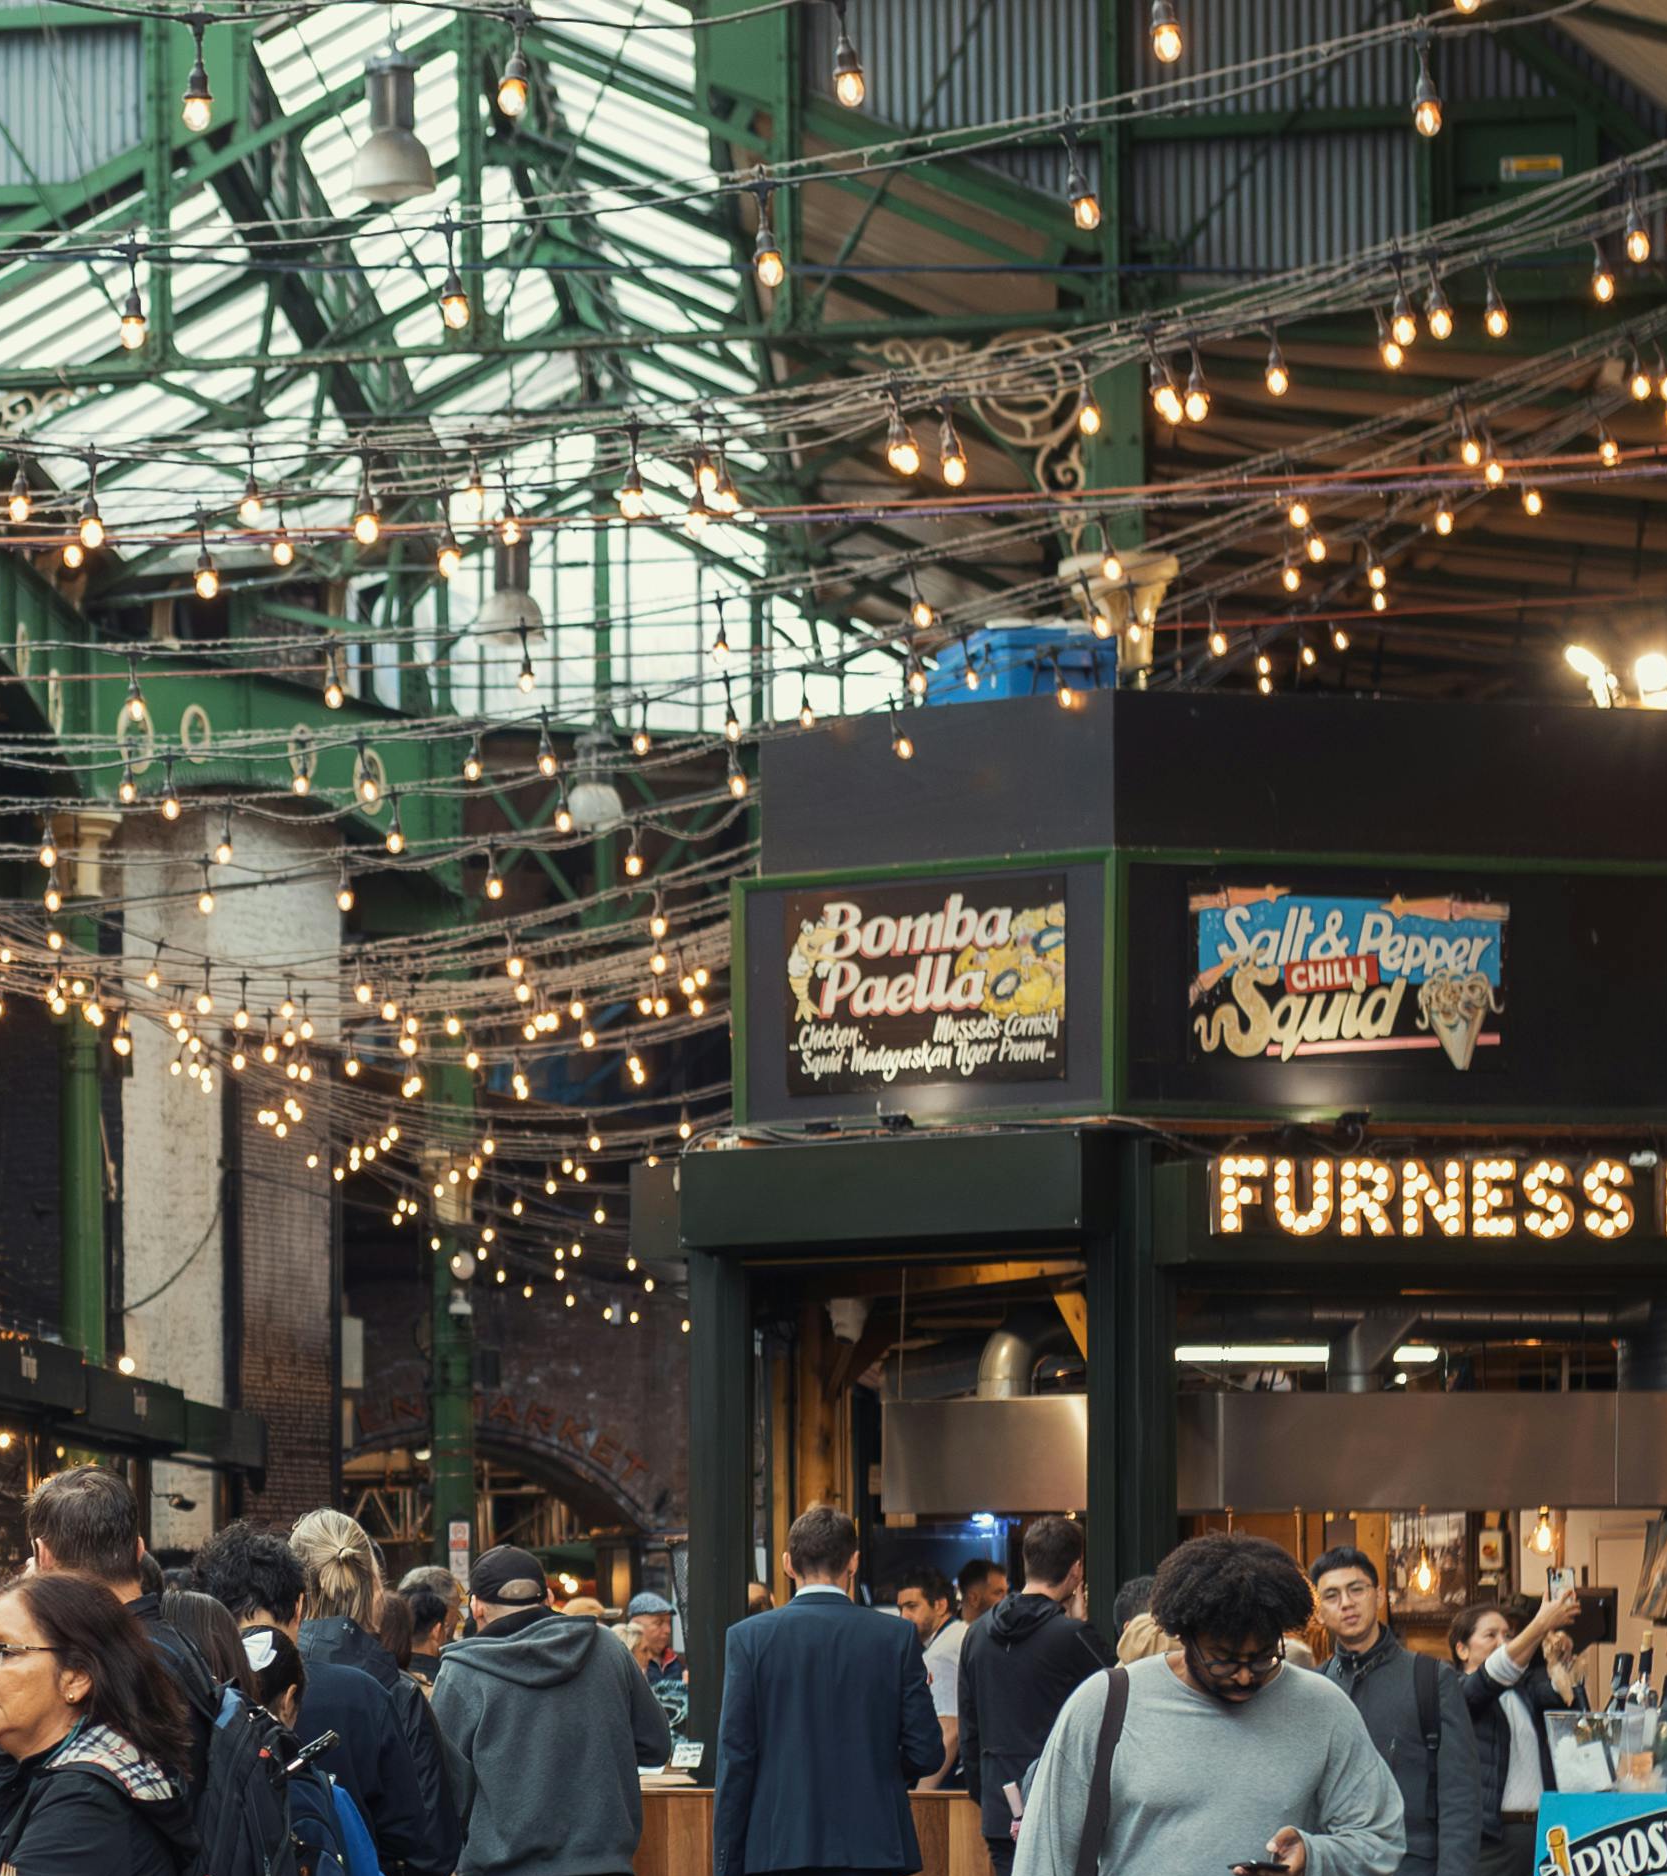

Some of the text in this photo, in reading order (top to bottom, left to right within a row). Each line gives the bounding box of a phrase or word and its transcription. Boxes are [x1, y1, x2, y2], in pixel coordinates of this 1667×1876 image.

[820, 893, 1014, 960] Bomba
[1217, 905, 1493, 977] Salt & Pepper
[818, 953, 988, 1020] Paella
[1193, 966, 1407, 1064] Squid
[1211, 1156, 1635, 1241] FURNESS
